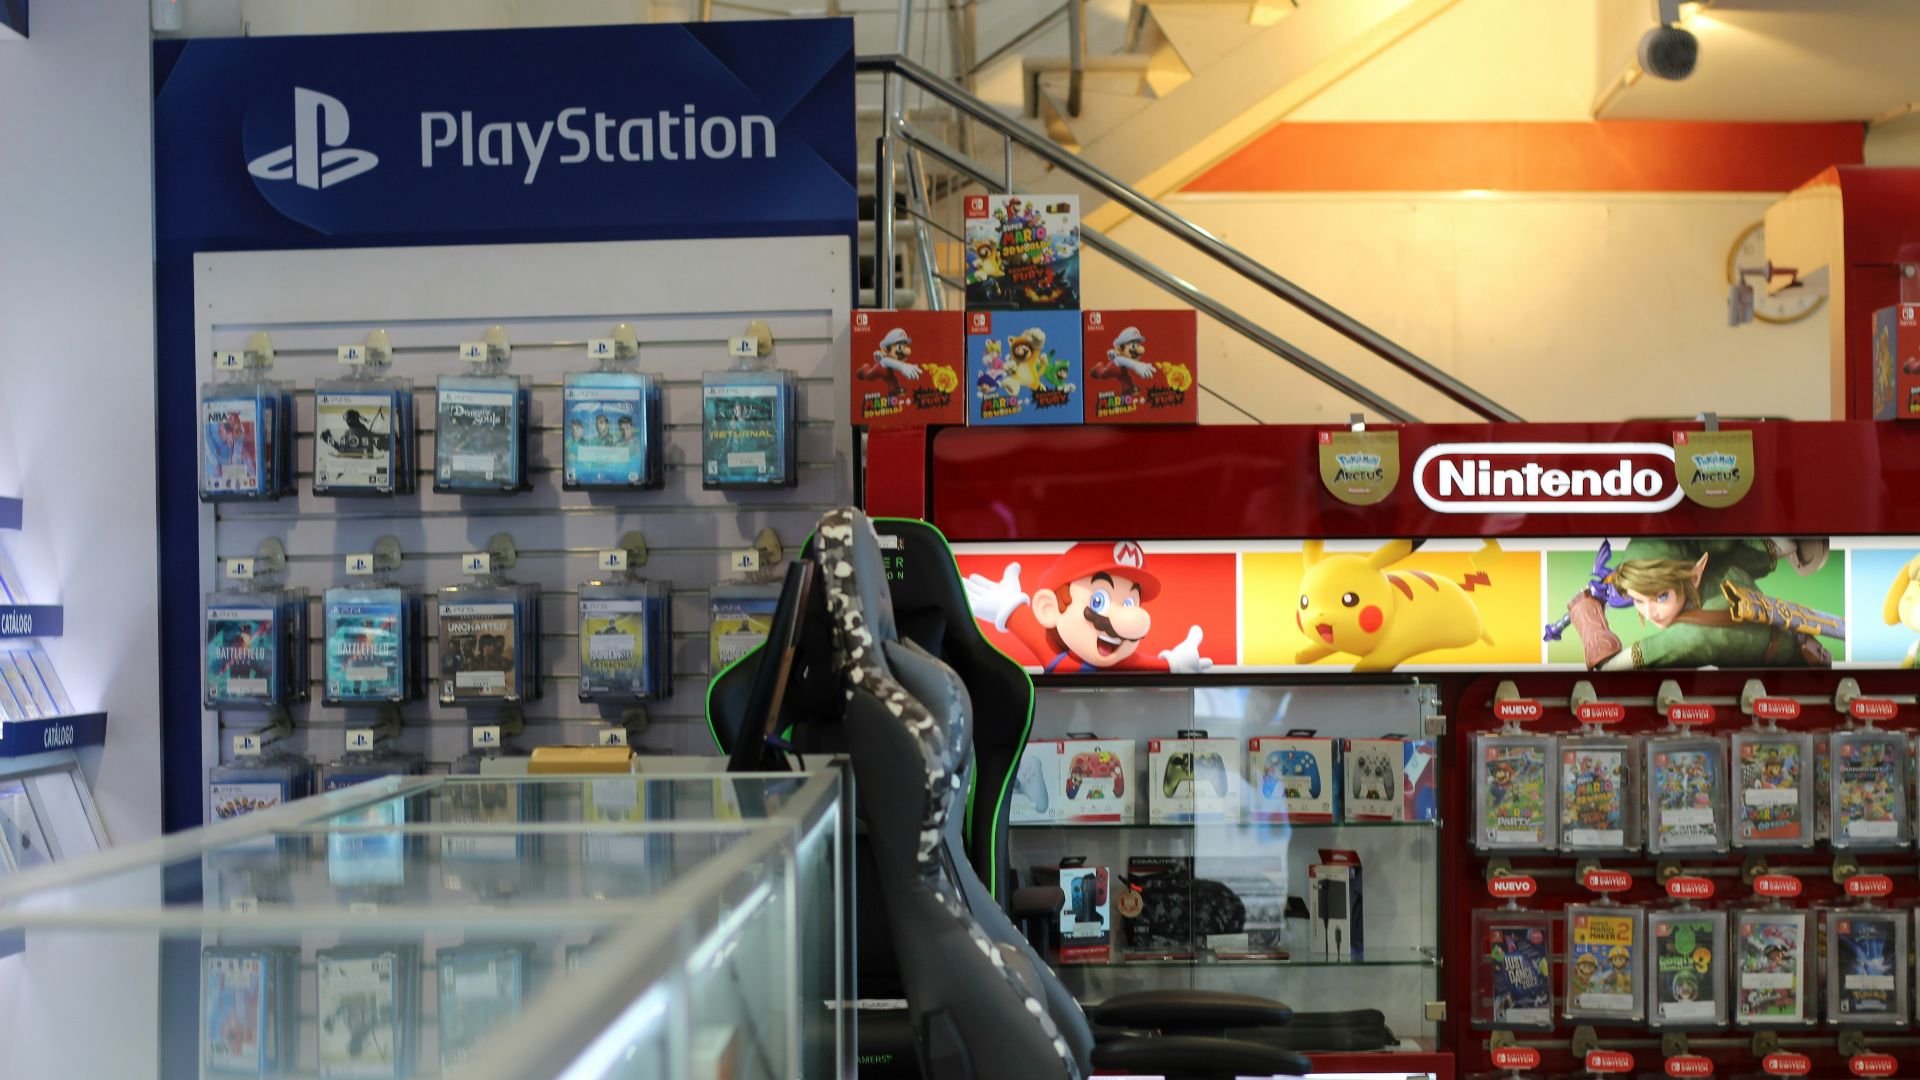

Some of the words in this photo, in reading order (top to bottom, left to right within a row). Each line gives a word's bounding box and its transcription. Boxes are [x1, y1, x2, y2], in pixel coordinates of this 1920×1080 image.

[421, 103, 776, 184] PlayStation
[1003, 223, 1023, 232] SUPER
[1003, 227, 1047, 246] MARIO
[1016, 241, 1048, 253] WORLD
[864, 395, 898, 410] MARIO
[983, 395, 1016, 410] MARIO
[1098, 394, 1132, 409] MARIO
[208, 413, 228, 423] NBA
[709, 429, 773, 440] RETURNAL
[1333, 467, 1384, 484] ARCEUS
[1439, 459, 1663, 497] Nintendo
[1690, 467, 1740, 485] ARCEUS
[1, 609, 33, 634] CATÁLOGO
[448, 622, 507, 633] UNCHARTED
[216, 647, 265, 660] BATTLEFIELD
[337, 642, 389, 656] BATTLEFIELD
[590, 661, 633, 669] EXTRACTION
[1501, 706, 1537, 715] NUEVO
[1768, 706, 1794, 714] SWITCH
[44, 723, 74, 748] CATÁLOGO
[1497, 816, 1531, 826] PARTY
[1494, 882, 1530, 891] NUEVO
[1616, 922, 1630, 941] 2
[1504, 956, 1523, 971] JUST
[1692, 947, 1711, 974] 3
